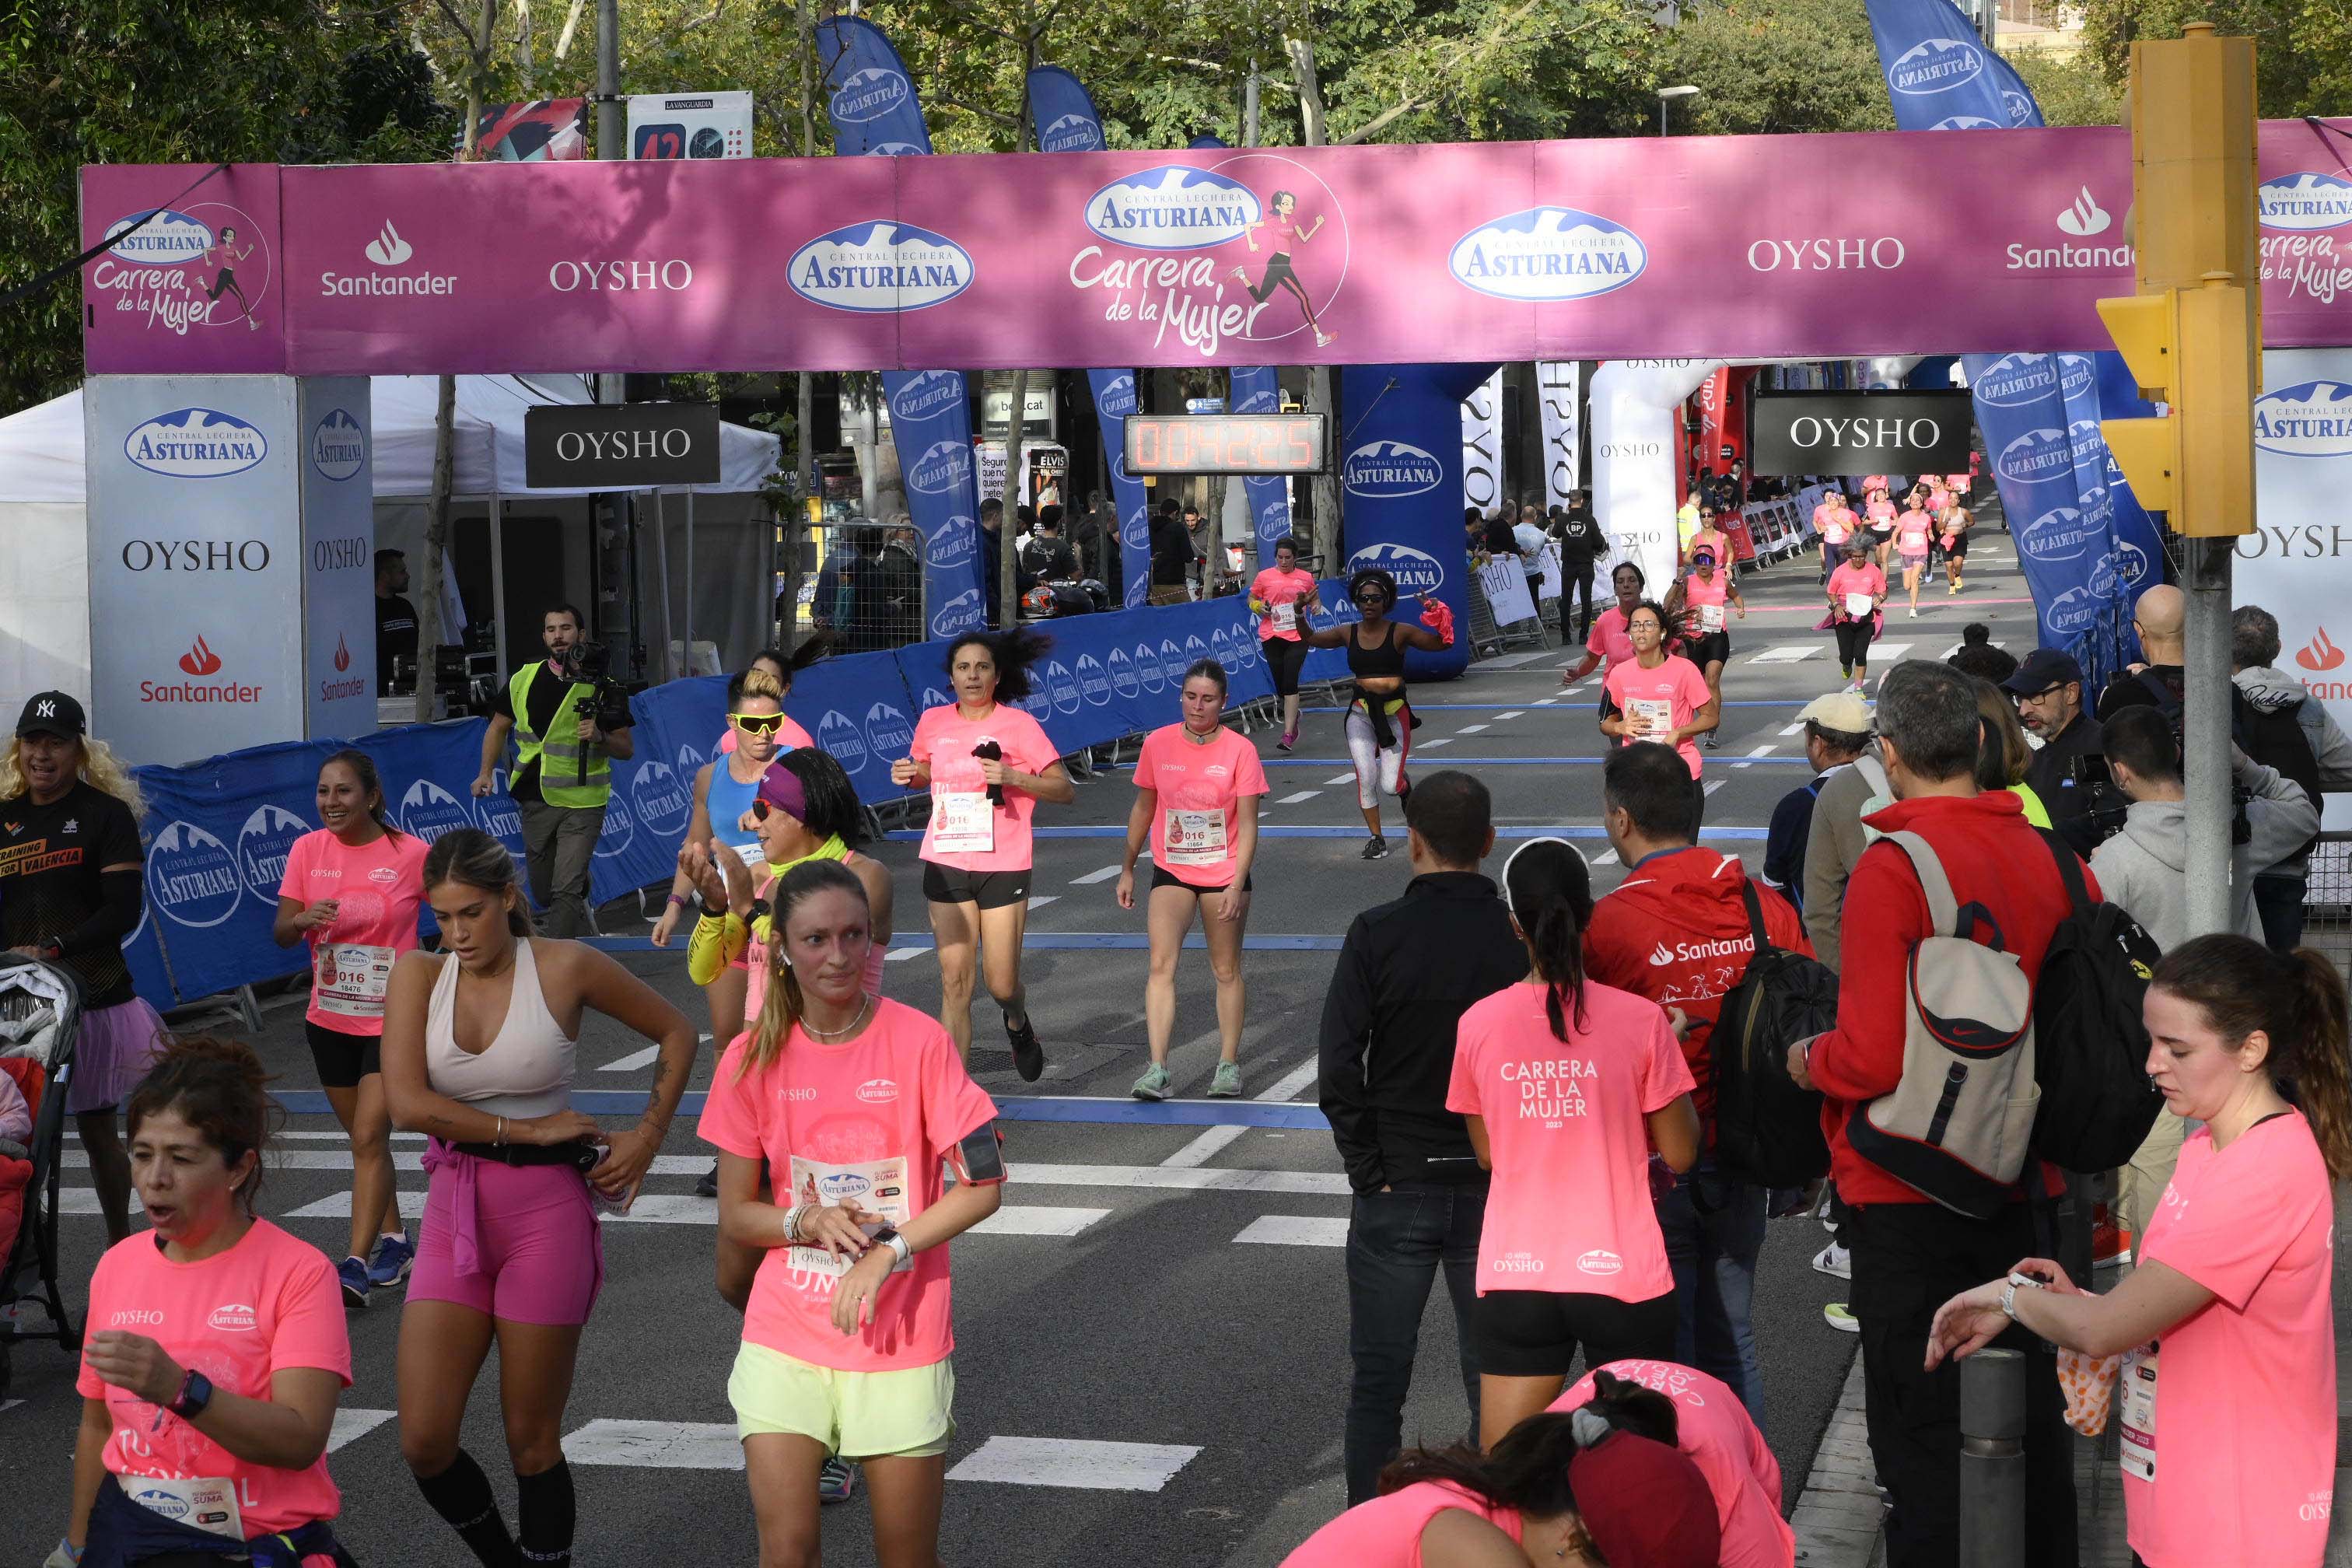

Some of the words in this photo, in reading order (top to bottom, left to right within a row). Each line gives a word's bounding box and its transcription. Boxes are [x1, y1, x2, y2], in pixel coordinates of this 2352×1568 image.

[1125, 194, 1181, 205] CENTRAL
[1185, 193, 1243, 204] LECHERA
[1097, 197, 1247, 229] ASTURIANA
[112, 229, 206, 250] ASTURIANA
[2259, 235, 2334, 257] arrera
[830, 252, 890, 261] CENTRAL
[895, 250, 954, 261] LECHERA
[1464, 243, 1632, 278] ASTURIANA
[1748, 237, 1906, 271] OYSHO
[94, 261, 186, 290] Carrera
[549, 260, 692, 292] OYSHO
[801, 255, 961, 290] ASTURIANA
[1069, 246, 1214, 289] Carrera
[2277, 257, 2292, 280] la
[2289, 253, 2352, 304] Muje
[321, 271, 457, 296] Santander
[117, 291, 133, 311] de
[137, 289, 149, 311] la
[147, 287, 220, 335] Mujer
[1105, 291, 1132, 322] de
[1139, 288, 1157, 321] la
[1153, 282, 1270, 357] Mujer
[1790, 417, 1941, 449] OYSHO
[135, 434, 257, 460] ASTURIANA
[317, 436, 362, 464] ASTURIANA
[556, 429, 691, 461] OYSHO
[1601, 443, 1660, 458] OYSHO
[1040, 456, 1064, 466] ELVIS
[1347, 464, 1436, 485] ASTURIANA
[122, 540, 270, 572] OYSHO
[314, 537, 366, 572] OYSHO
[141, 681, 262, 703] Santander
[321, 677, 365, 702] Santander
[481, 805, 523, 838] ASTUR
[1185, 831, 1205, 840] 016
[0, 842, 41, 861] RAINING
[1, 864, 16, 876] FOR
[24, 851, 79, 873] VALENCIA
[310, 869, 341, 878] OYSHO
[158, 865, 237, 905] ASTURIANA
[1677, 933, 1755, 961] Santand
[338, 954, 368, 964] ASTURIANA
[338, 971, 365, 983] 016
[1500, 1059, 1598, 1081] CARRERA
[1521, 1081, 1548, 1100] DE
[1556, 1080, 1581, 1097] LA
[1519, 1098, 1587, 1118] MUJER
[824, 1182, 866, 1193] ASTURIANA
[875, 1173, 899, 1181] SUMA
[802, 1254, 834, 1267] OYSHO
[1493, 1259, 1544, 1272] OYSHO
[1580, 1258, 1621, 1270] ASTURIANA
[194, 1495, 224, 1504] SUMA
